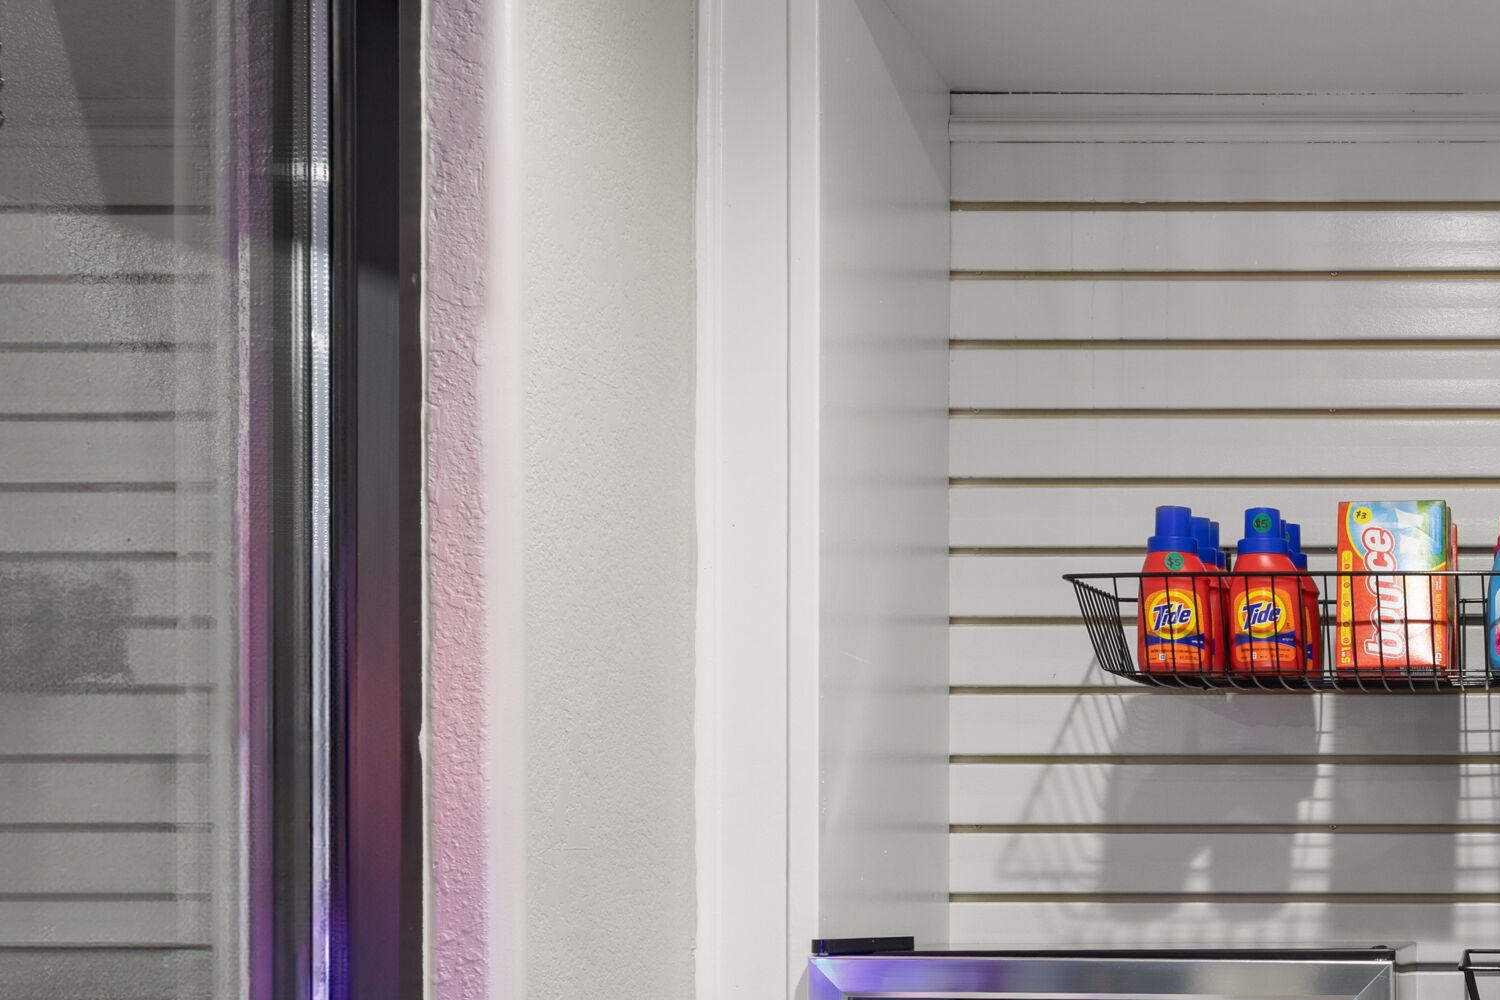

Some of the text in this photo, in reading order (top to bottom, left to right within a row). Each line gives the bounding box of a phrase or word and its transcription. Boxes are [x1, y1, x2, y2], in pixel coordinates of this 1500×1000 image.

[1253, 518, 1269, 530] $5
[1166, 557, 1181, 568] $5
[1361, 526, 1407, 660] bounce
[1152, 602, 1192, 632] Tide
[1242, 602, 1281, 632] Tide
